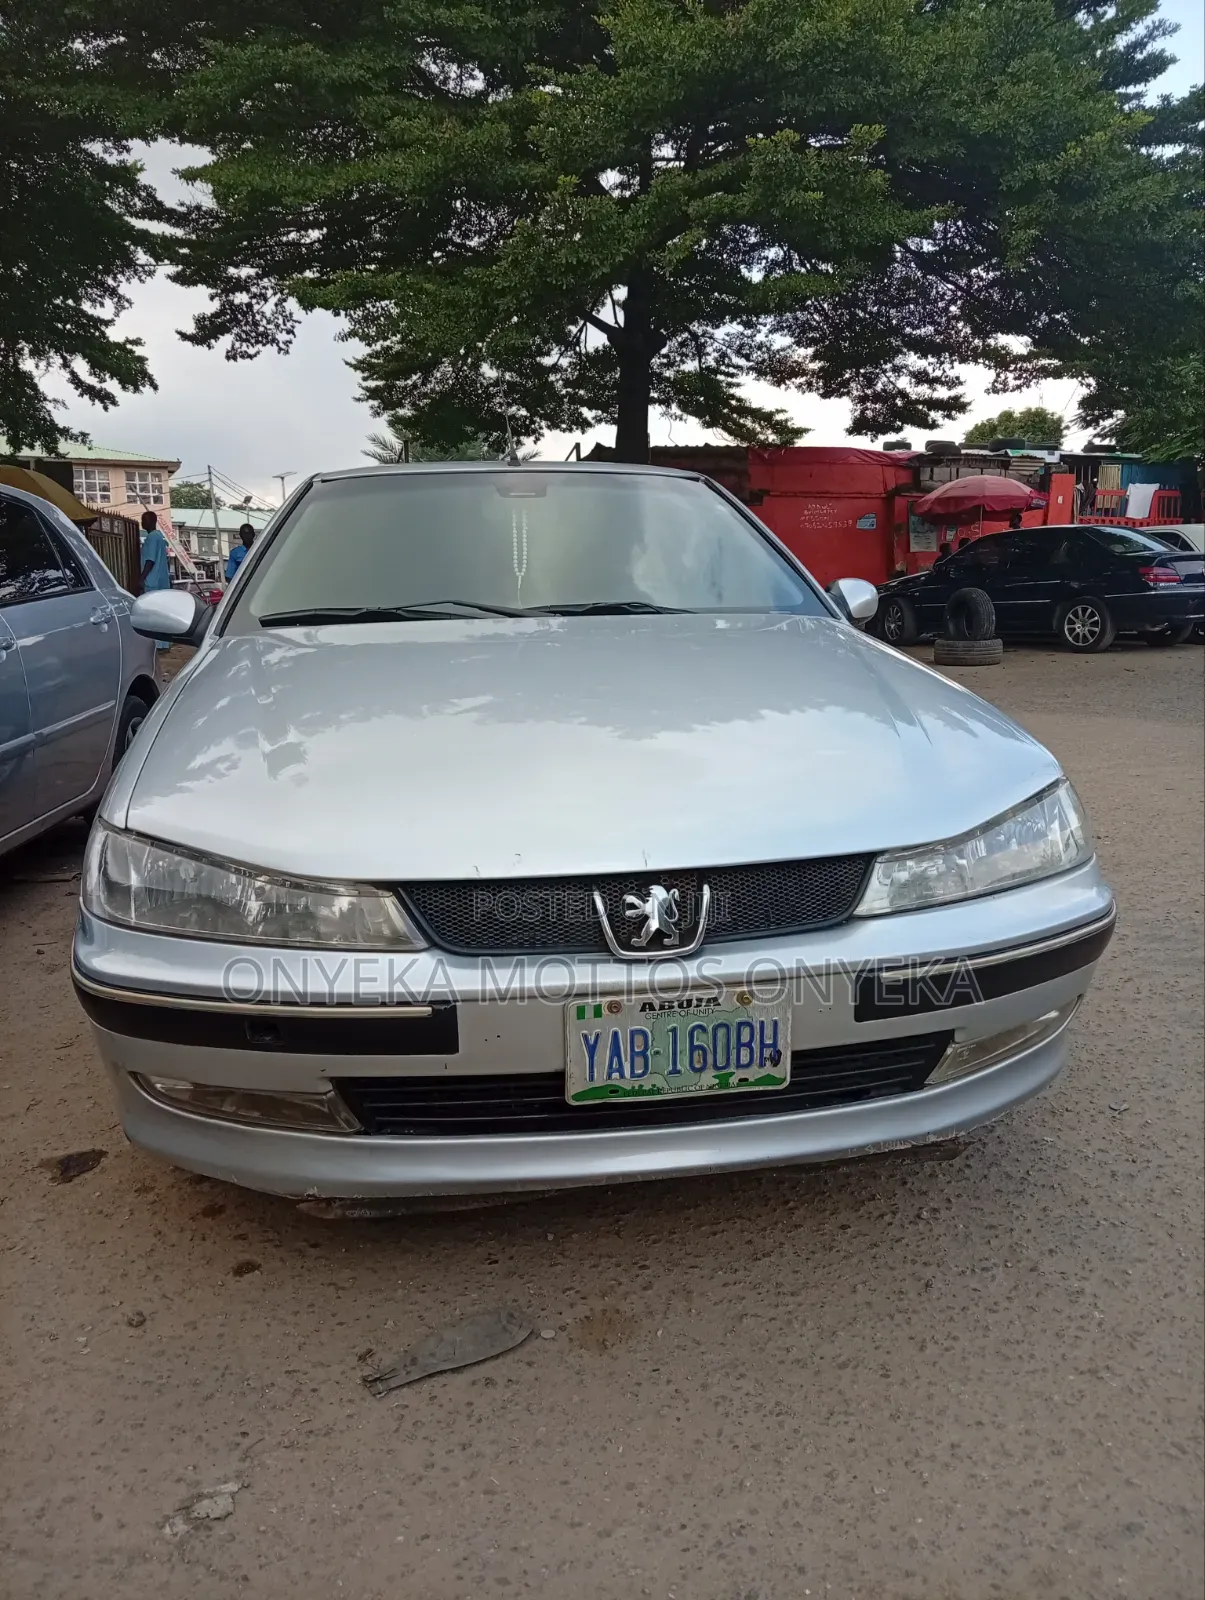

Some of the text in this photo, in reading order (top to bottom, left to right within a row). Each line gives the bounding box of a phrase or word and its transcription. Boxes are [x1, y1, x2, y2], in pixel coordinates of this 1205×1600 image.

[639, 996, 721, 1012] ABUJA
[645, 1007, 716, 1020] CENTRE OF UNITY
